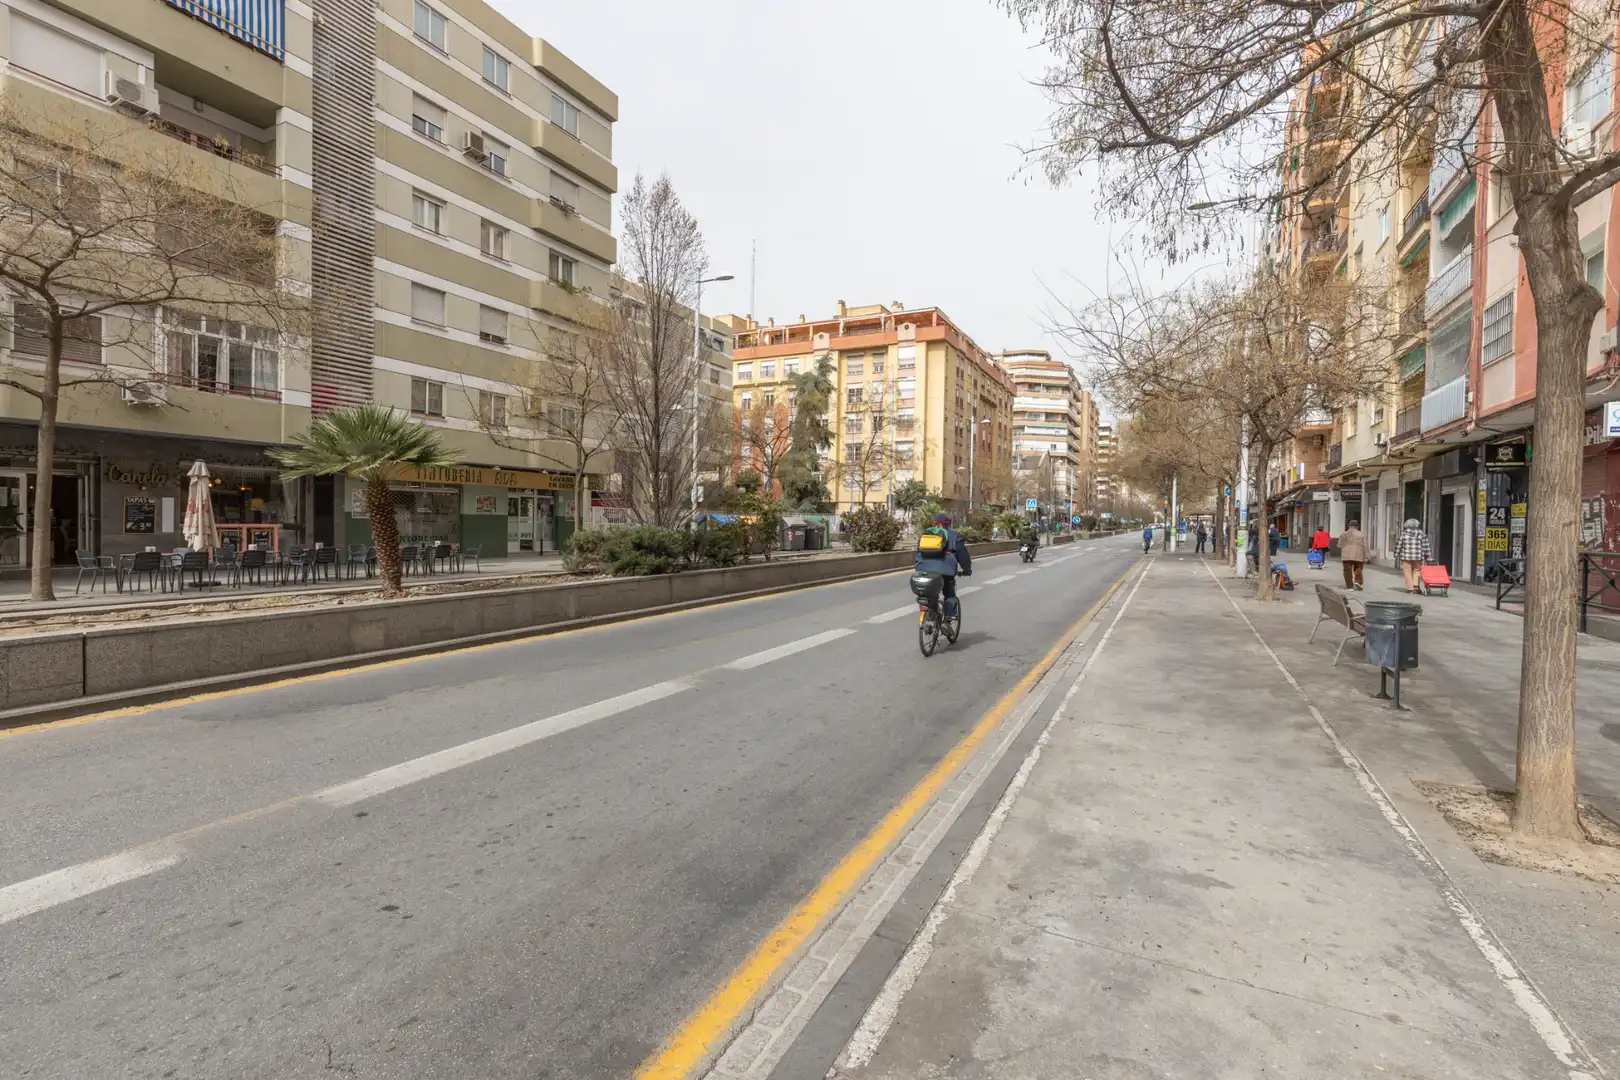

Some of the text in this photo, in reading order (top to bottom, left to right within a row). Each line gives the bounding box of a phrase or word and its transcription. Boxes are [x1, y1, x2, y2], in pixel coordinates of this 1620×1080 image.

[108, 464, 167, 486] Canela
[1489, 508, 1506, 520] 24
[1487, 529, 1507, 540] 365
